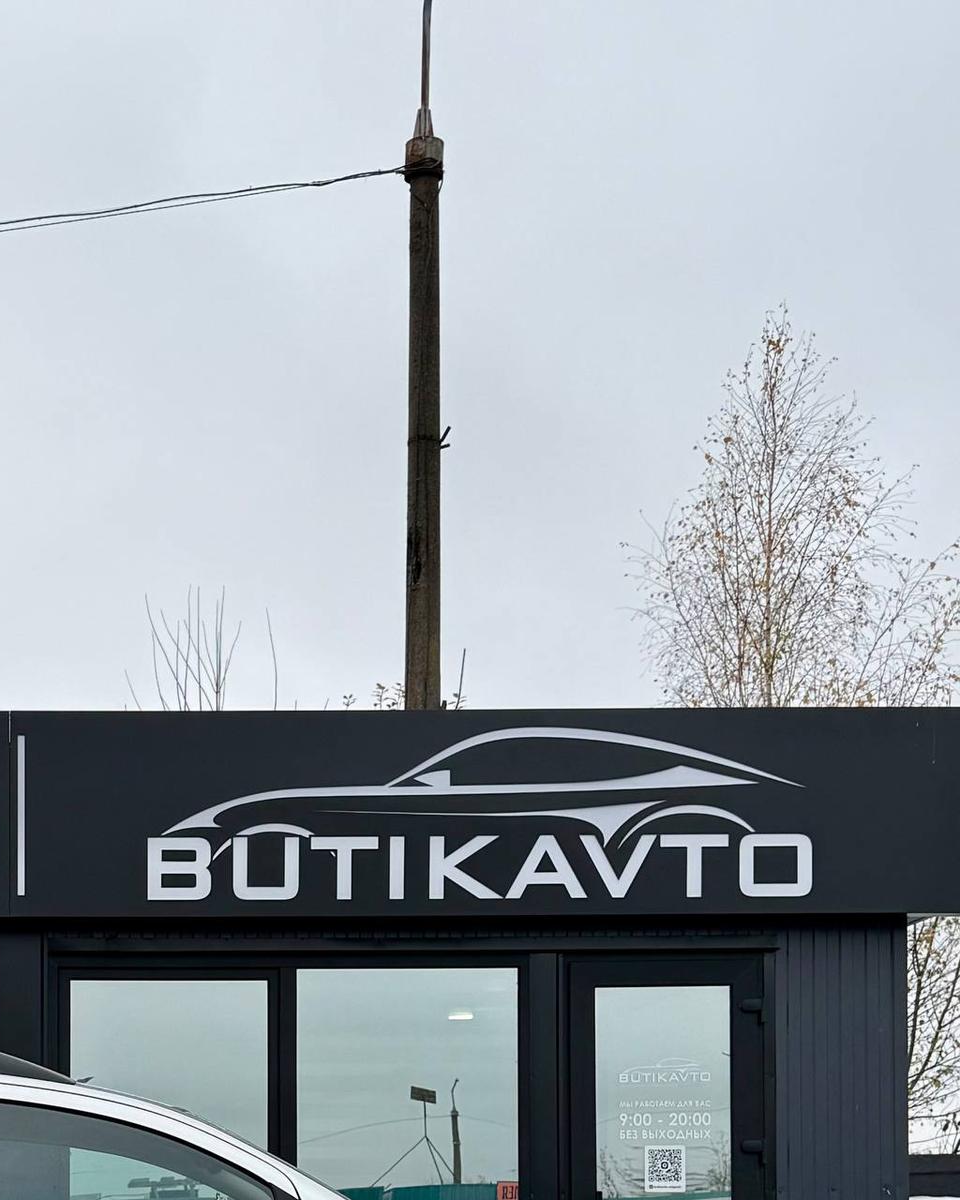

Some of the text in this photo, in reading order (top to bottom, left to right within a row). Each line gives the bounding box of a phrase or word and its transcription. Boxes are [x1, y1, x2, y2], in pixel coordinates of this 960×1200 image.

[146, 833, 814, 901] BUTIKAVTO
[619, 1071, 711, 1083] BUTIKAVTO
[677, 1100, 693, 1108] ДЛЯ
[619, 1113, 652, 1126] 9:00
[669, 1113, 711, 1126] 20:00
[620, 1130, 711, 1140] БЕЗ ВЫХОДНЫХ
